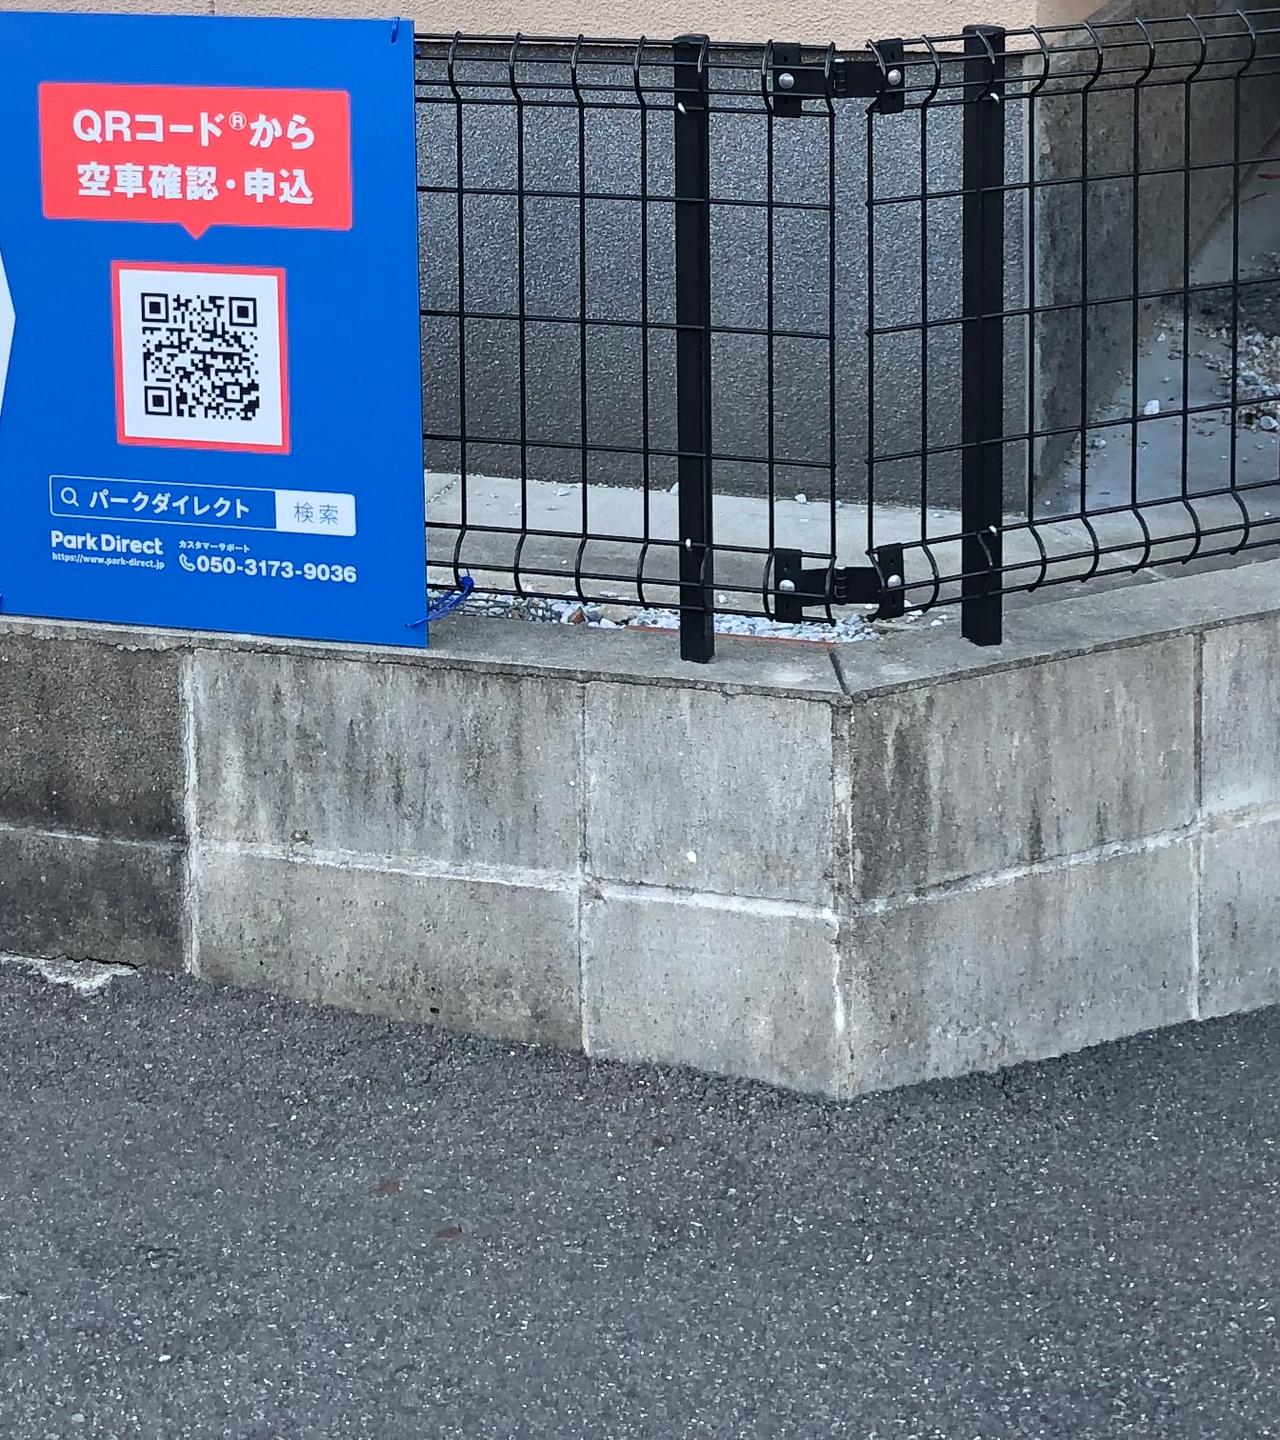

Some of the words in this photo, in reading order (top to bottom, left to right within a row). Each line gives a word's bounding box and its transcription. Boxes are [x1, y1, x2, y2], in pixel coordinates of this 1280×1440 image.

[76, 162, 315, 206] 空車確認・申込
[88, 489, 250, 520] パークダイレクト
[293, 501, 339, 525] 検索
[50, 529, 98, 551] Park
[101, 533, 164, 556] Direct
[178, 539, 250, 554] カスタマーサポート
[51, 552, 166, 570] https://www.park-direct.jp
[196, 554, 357, 584] 050-3173-9036
